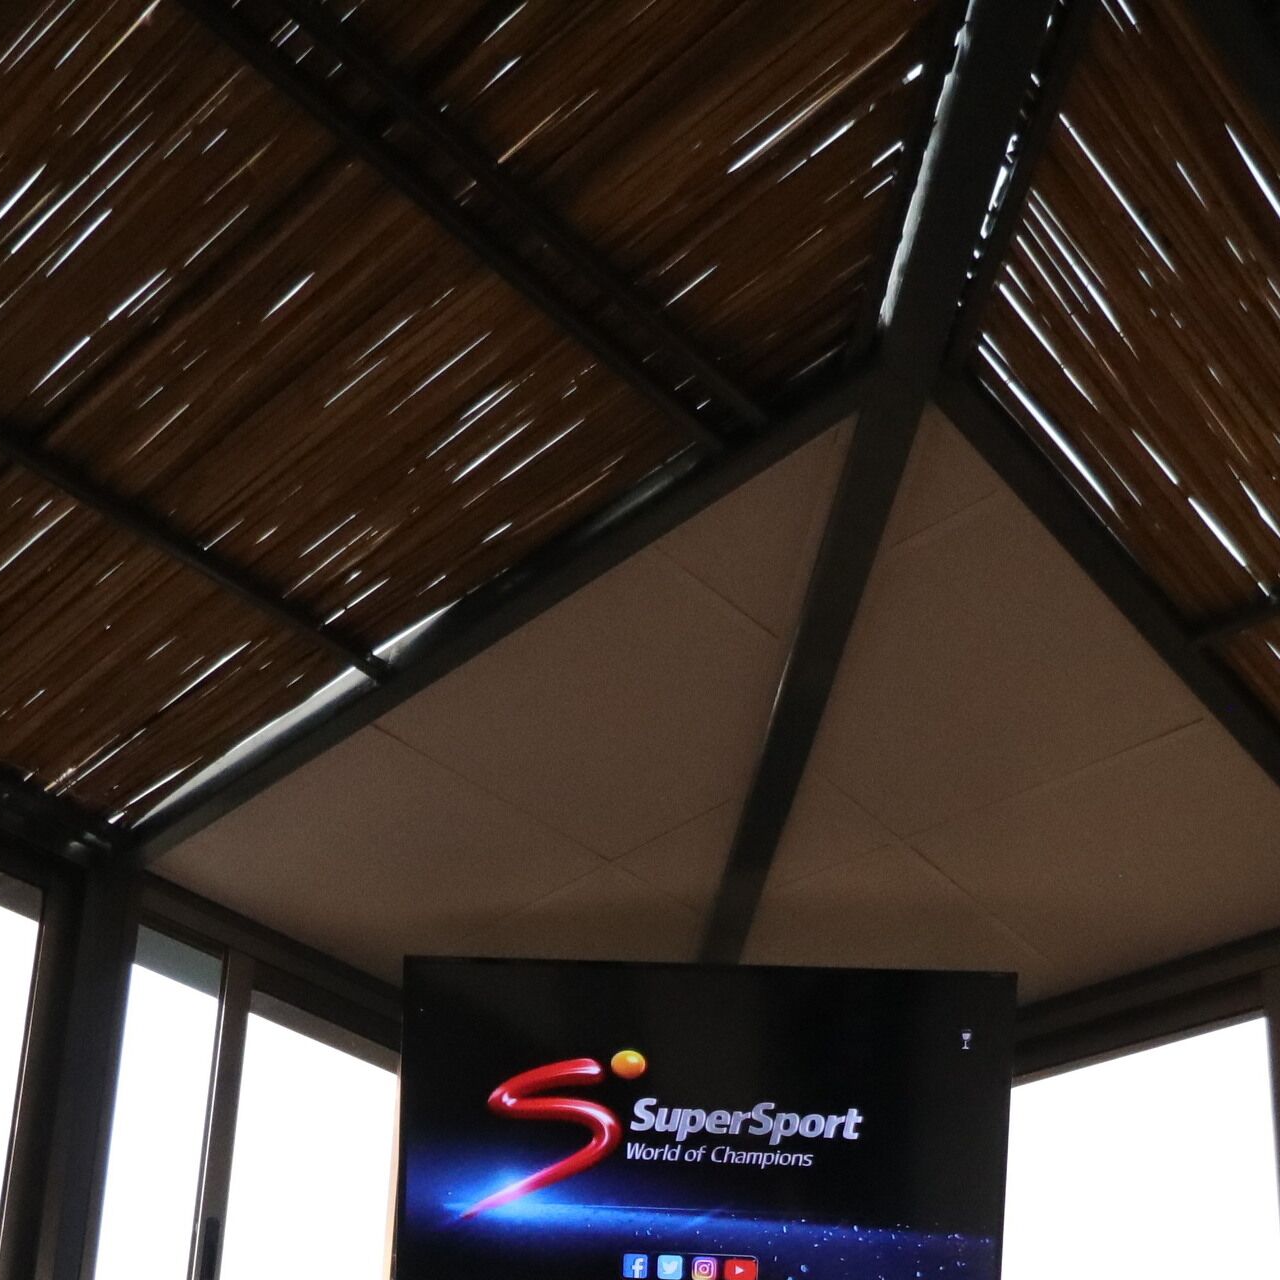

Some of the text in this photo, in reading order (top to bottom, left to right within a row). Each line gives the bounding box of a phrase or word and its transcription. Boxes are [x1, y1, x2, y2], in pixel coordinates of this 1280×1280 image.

[630, 1098, 863, 1145] SuperSport
[626, 1142, 814, 1169] World of Champions
